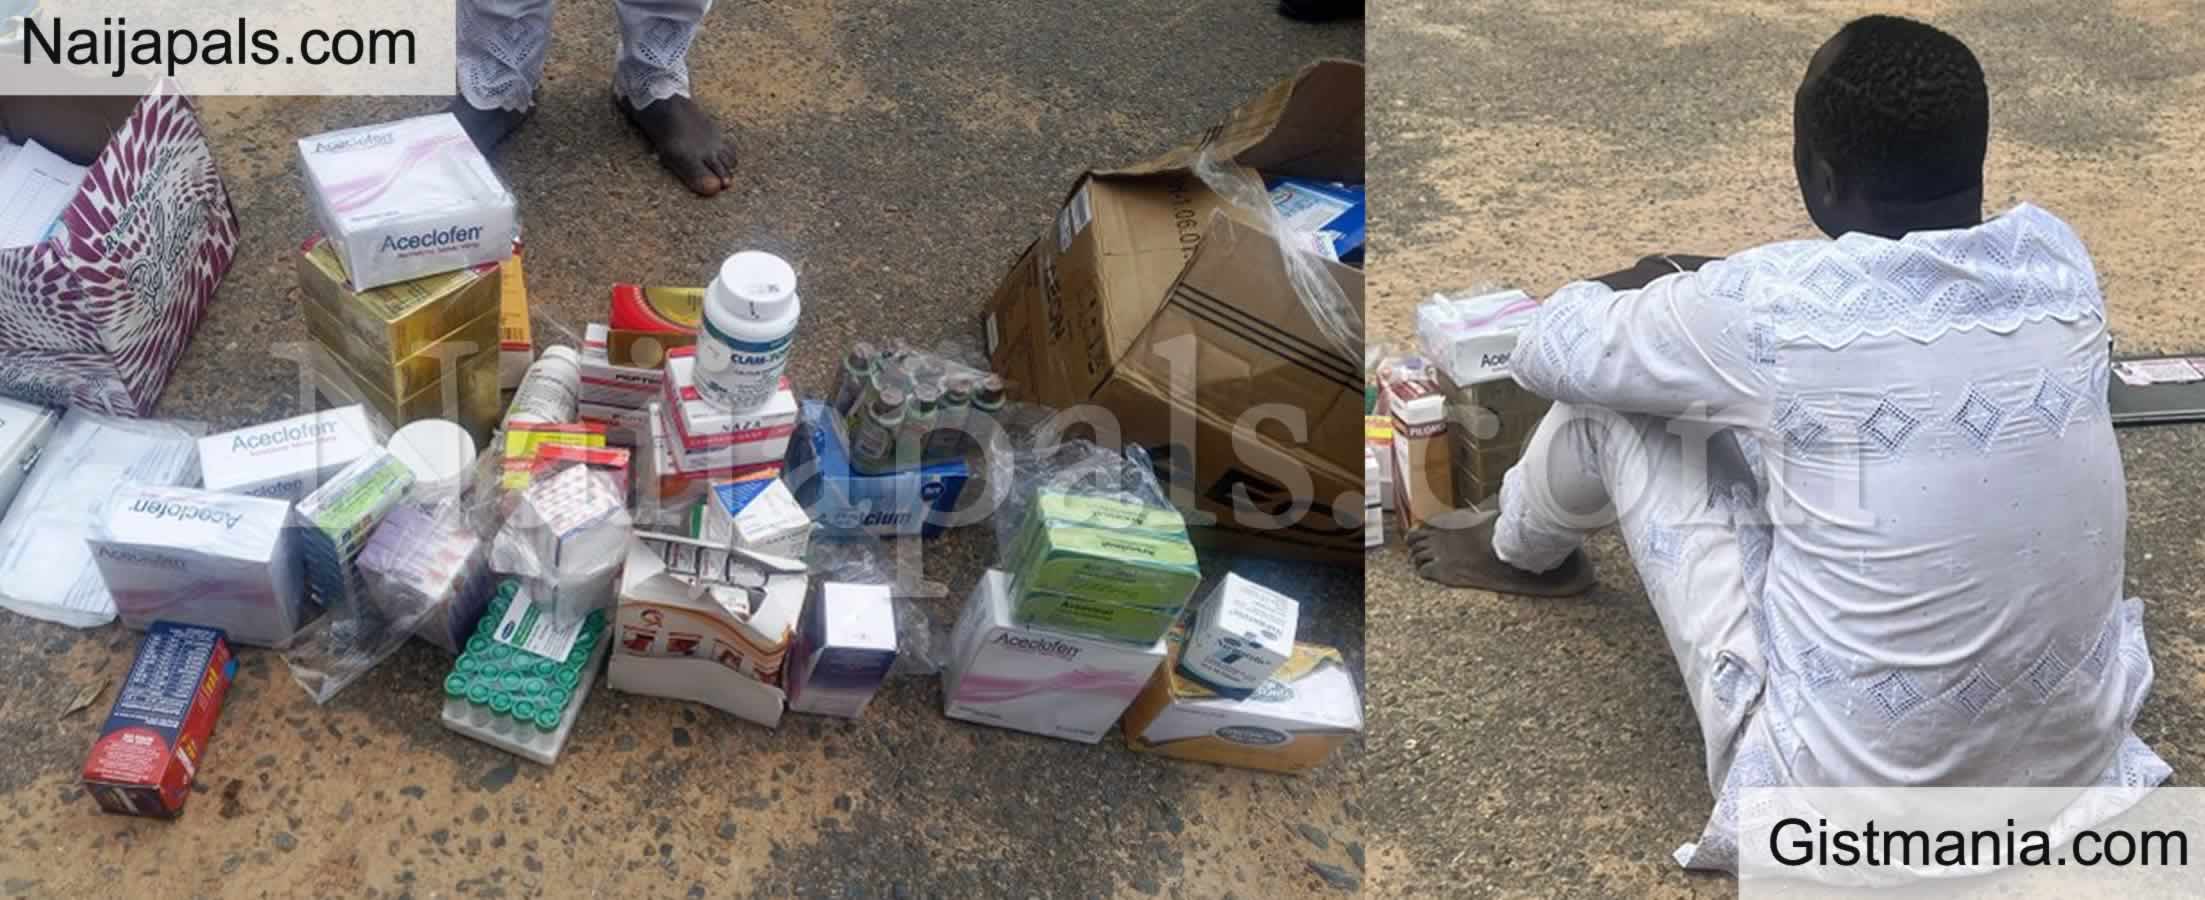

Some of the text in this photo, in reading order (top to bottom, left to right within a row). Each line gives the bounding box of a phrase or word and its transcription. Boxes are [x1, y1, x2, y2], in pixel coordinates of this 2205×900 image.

[381, 223, 481, 252] Aceclofen
[231, 420, 337, 453] Aceclofen
[129, 498, 244, 530] Aceclofen
[993, 631, 1082, 660] Aceclofen
